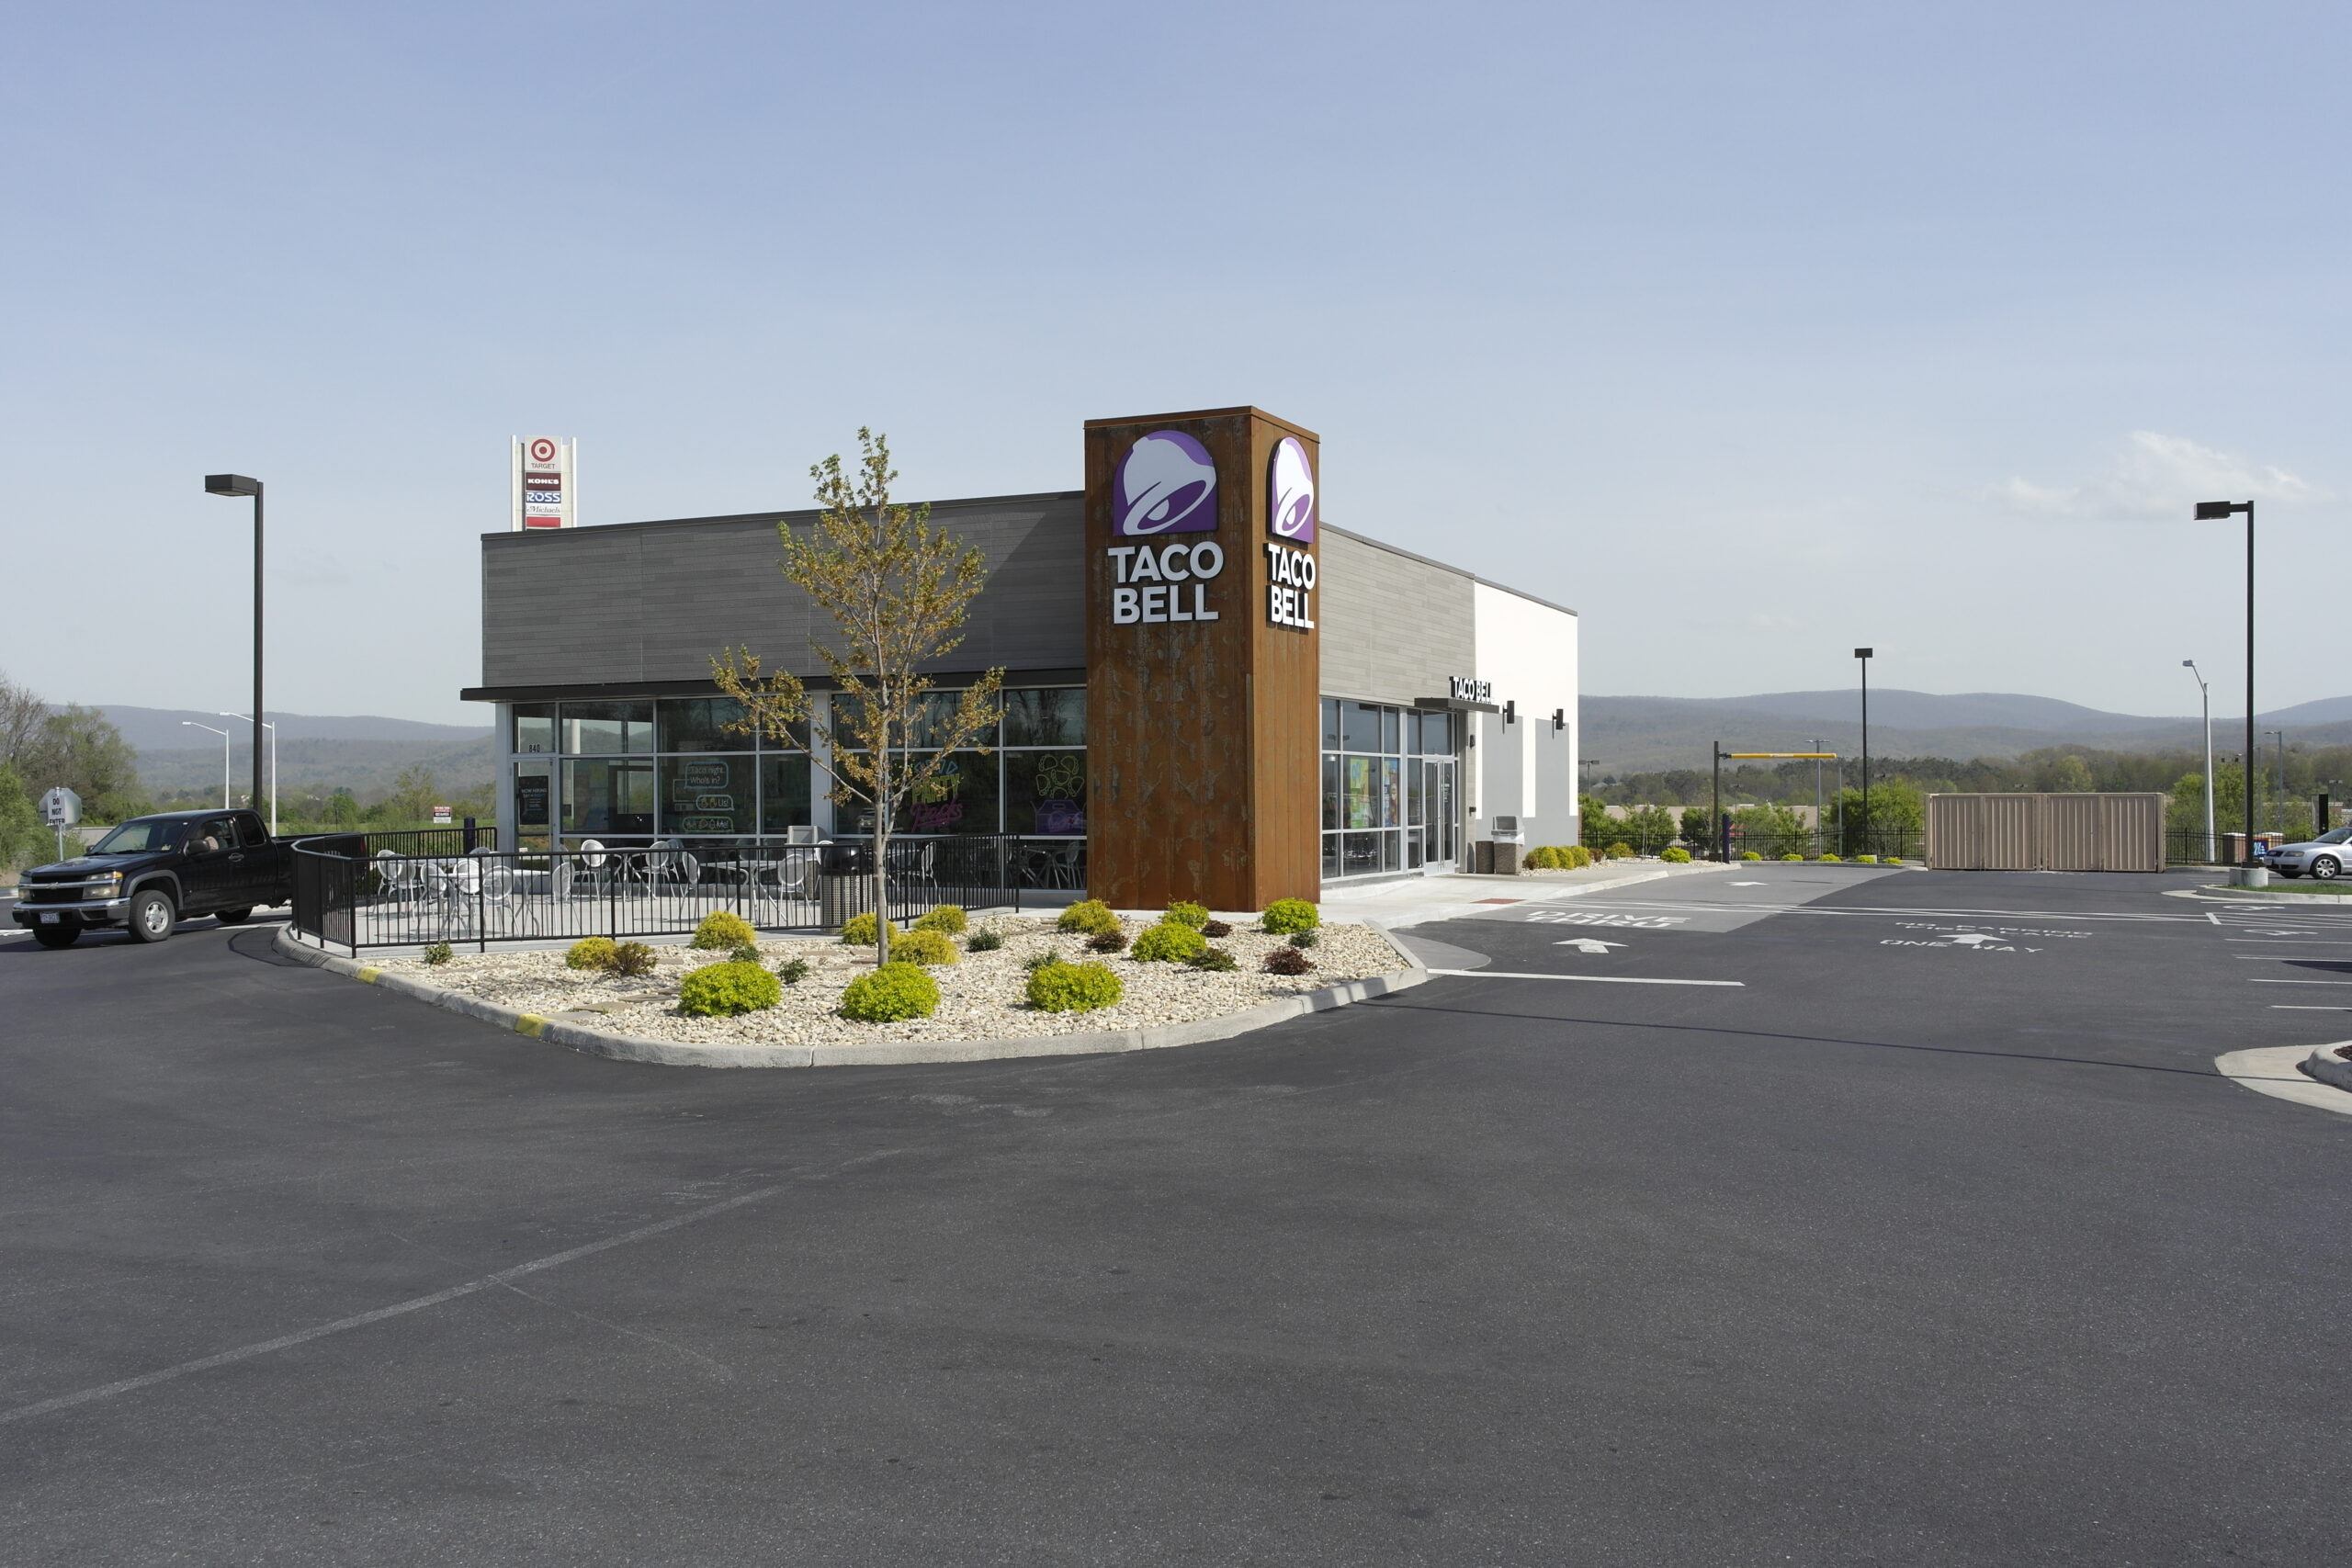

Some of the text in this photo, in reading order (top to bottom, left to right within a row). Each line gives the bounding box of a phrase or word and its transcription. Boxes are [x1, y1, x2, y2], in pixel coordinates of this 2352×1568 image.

[526, 492, 560, 502] ROSS
[526, 505, 560, 513] Michaels
[1107, 541, 1224, 583] TACO
[1268, 543, 1316, 591] TACO
[1114, 584, 1218, 625] BELL
[1271, 585, 1315, 629] BELL
[1453, 676, 1476, 700] TACO
[528, 744, 540, 753] 840
[911, 773, 960, 805] PARTY
[1524, 916, 1672, 928] THRU
[1528, 910, 1691, 923] DRIVE
[1880, 939, 2044, 953] ONE WAY
